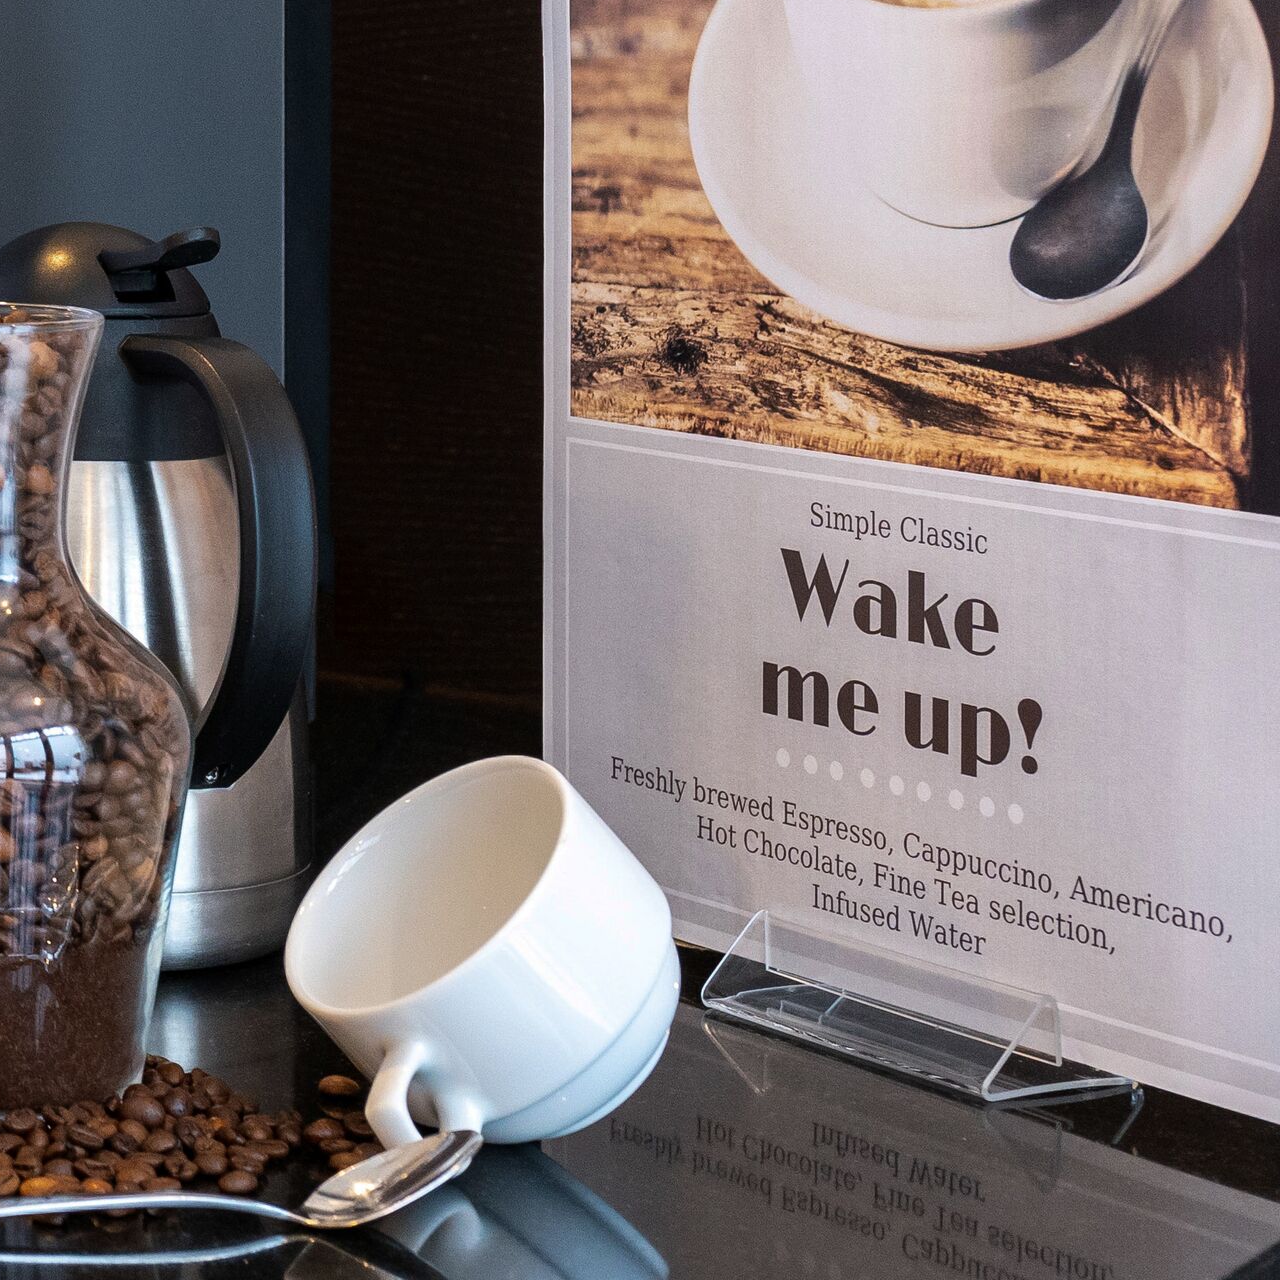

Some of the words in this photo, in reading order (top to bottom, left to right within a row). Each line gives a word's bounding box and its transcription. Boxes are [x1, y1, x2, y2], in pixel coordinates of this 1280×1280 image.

[810, 502, 891, 540] Simple
[900, 516, 988, 554] Classic
[780, 548, 999, 656] Wake
[762, 661, 879, 736] me
[904, 691, 1043, 778] up!
[611, 756, 687, 803] Freshly
[693, 776, 774, 821] brewed
[782, 801, 894, 856] Espresso,
[903, 833, 1060, 900] Cappuccino,
[1070, 875, 1234, 944] Americano,
[697, 815, 737, 848] Hot
[744, 829, 864, 887] Chocolate,
[873, 862, 926, 900] Fine
[934, 878, 980, 915] Tea
[990, 900, 1116, 956] selection,
[812, 883, 901, 932] Infused
[909, 910, 987, 956] Water
